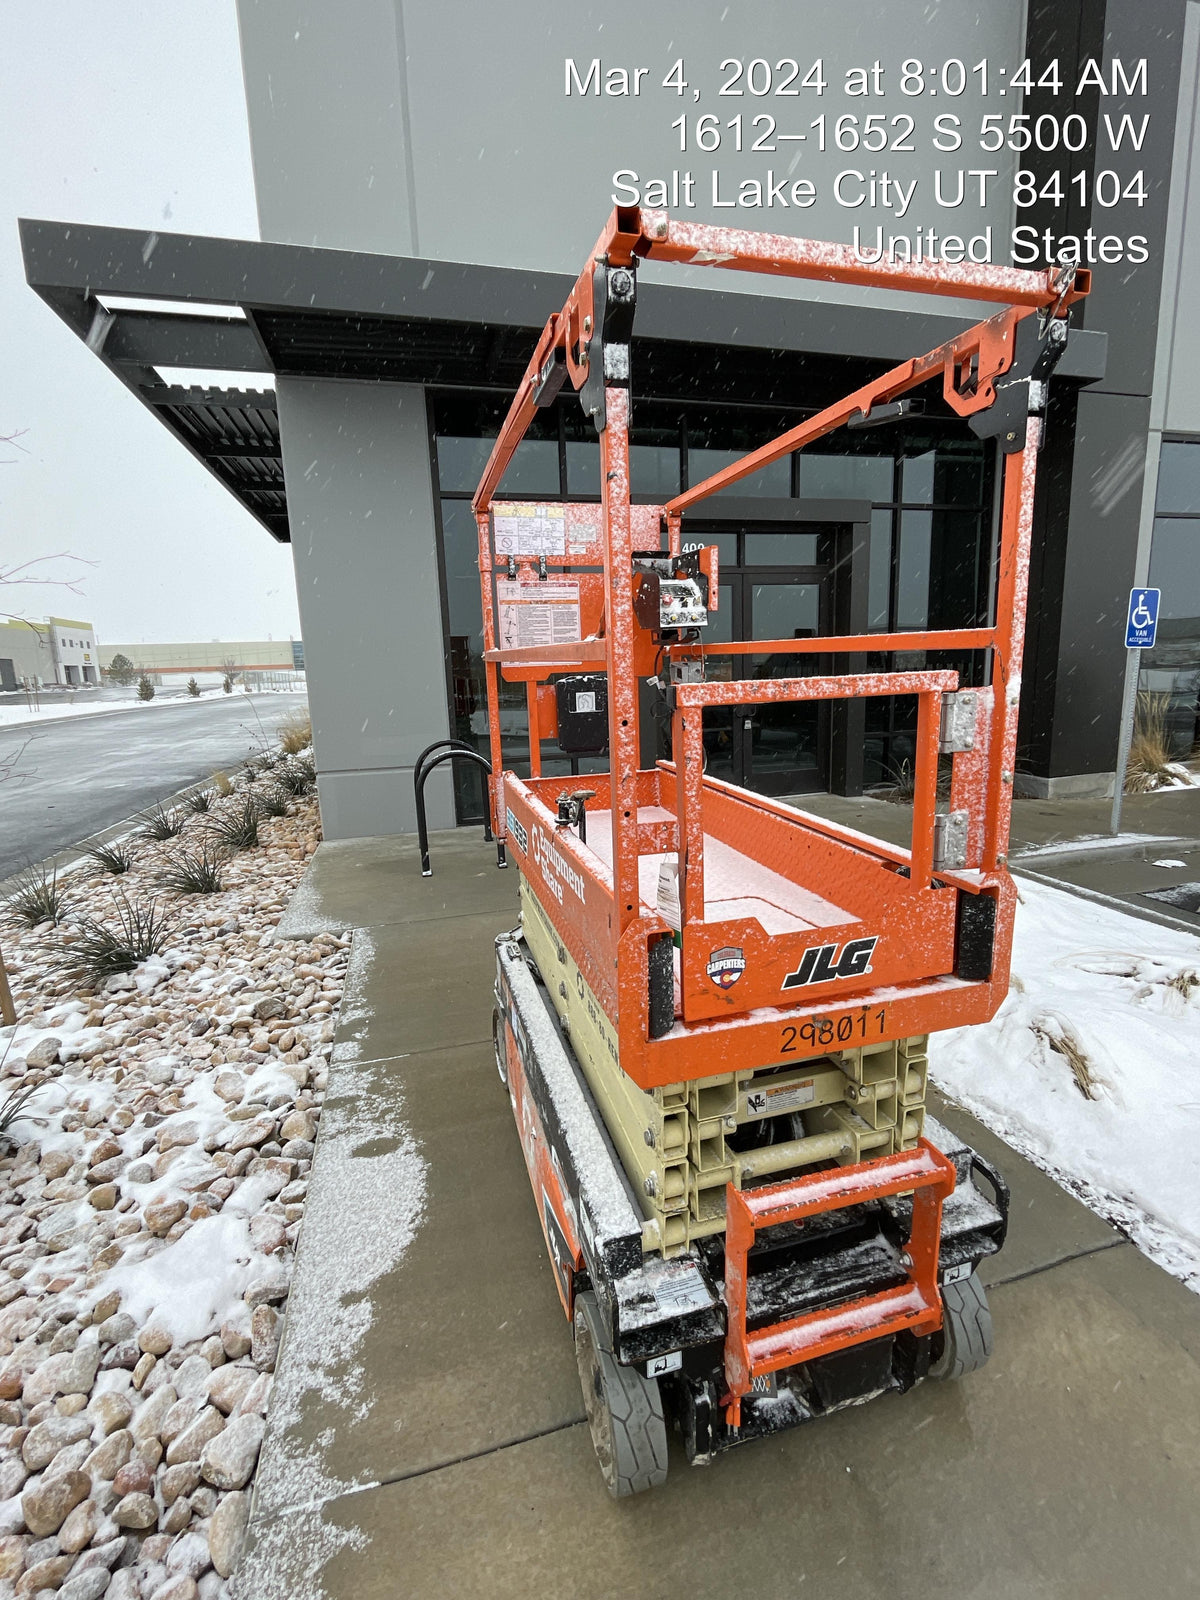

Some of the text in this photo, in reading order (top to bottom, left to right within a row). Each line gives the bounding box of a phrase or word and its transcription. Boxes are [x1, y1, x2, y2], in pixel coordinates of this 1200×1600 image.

[539, 825, 586, 905] Equipment
[706, 959, 746, 974] CARPENTERS
[781, 935, 879, 990] JLG
[780, 1009, 886, 1053] 298011
